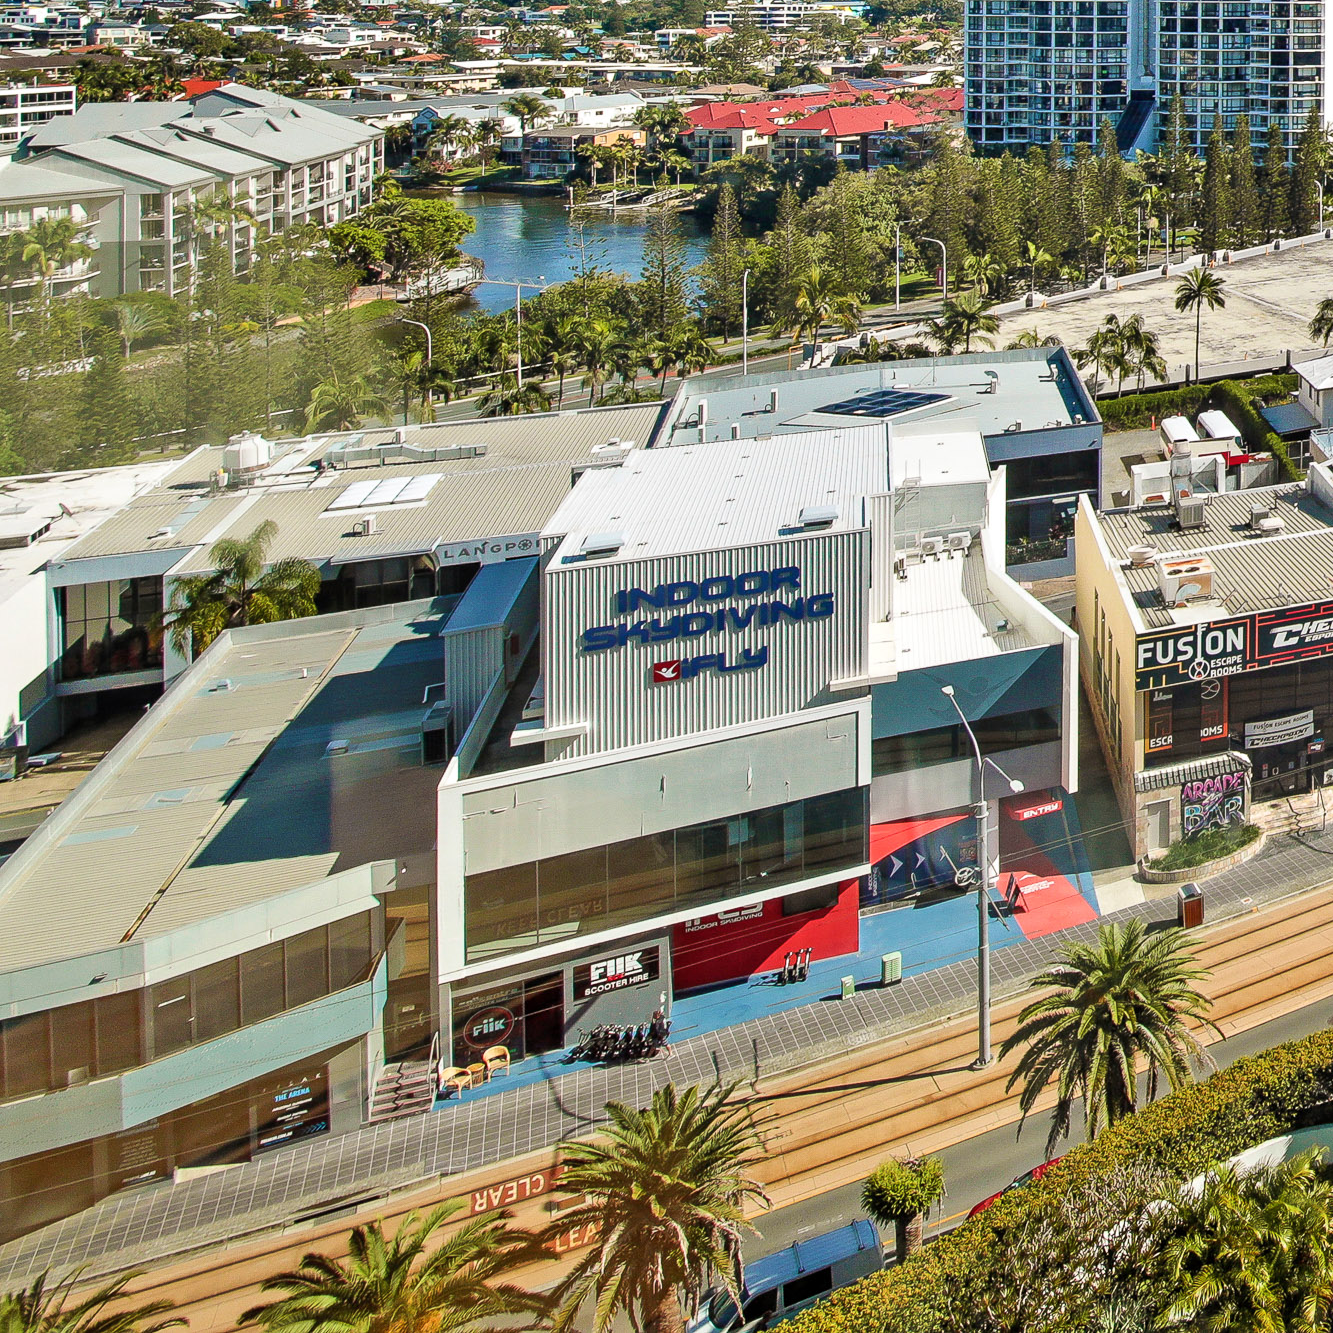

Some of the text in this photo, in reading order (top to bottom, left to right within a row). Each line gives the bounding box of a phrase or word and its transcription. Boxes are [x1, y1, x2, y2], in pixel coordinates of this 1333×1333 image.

[616, 565, 800, 614] INDOOR
[583, 592, 835, 653] SKYDIVING
[1138, 623, 1244, 669] FUSION
[1210, 654, 1243, 668] ESCAPE
[1210, 664, 1243, 678] ROOMS
[1150, 735, 1173, 748] ESCA
[1248, 726, 1310, 746] CHECKPOINT
[1182, 772, 1244, 802] ARCADE
[1023, 802, 1059, 818] ENTRY
[1184, 796, 1246, 833] BAR
[685, 911, 763, 933] INDOOR SKYDIVING
[584, 972, 649, 996] SCOOTER HIRE
[474, 1174, 545, 1212] CLEAR
